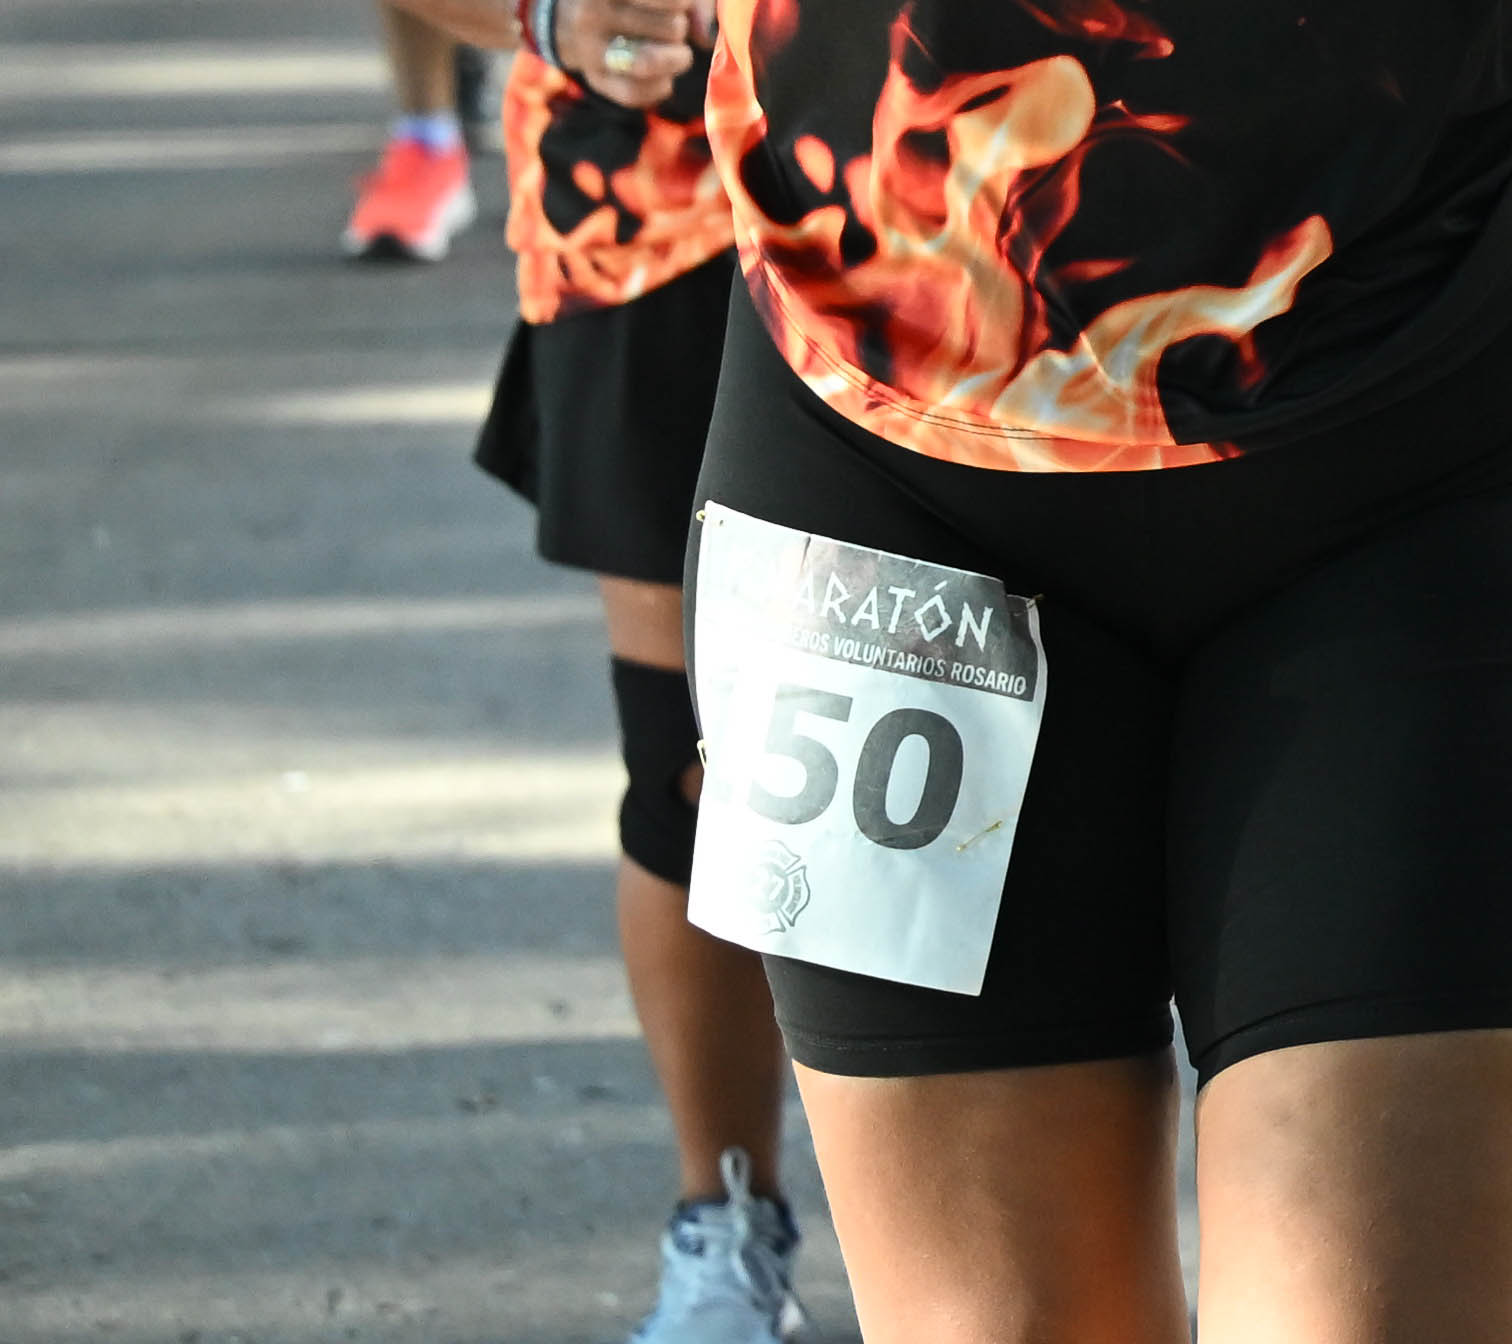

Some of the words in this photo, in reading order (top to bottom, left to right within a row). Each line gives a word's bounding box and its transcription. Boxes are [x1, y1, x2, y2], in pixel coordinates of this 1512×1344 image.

[795, 570, 994, 654] ARATÓN
[833, 637, 947, 678] VOLUNTARIOS
[951, 663, 1028, 696] ROSARIO
[706, 676, 964, 850] 50
